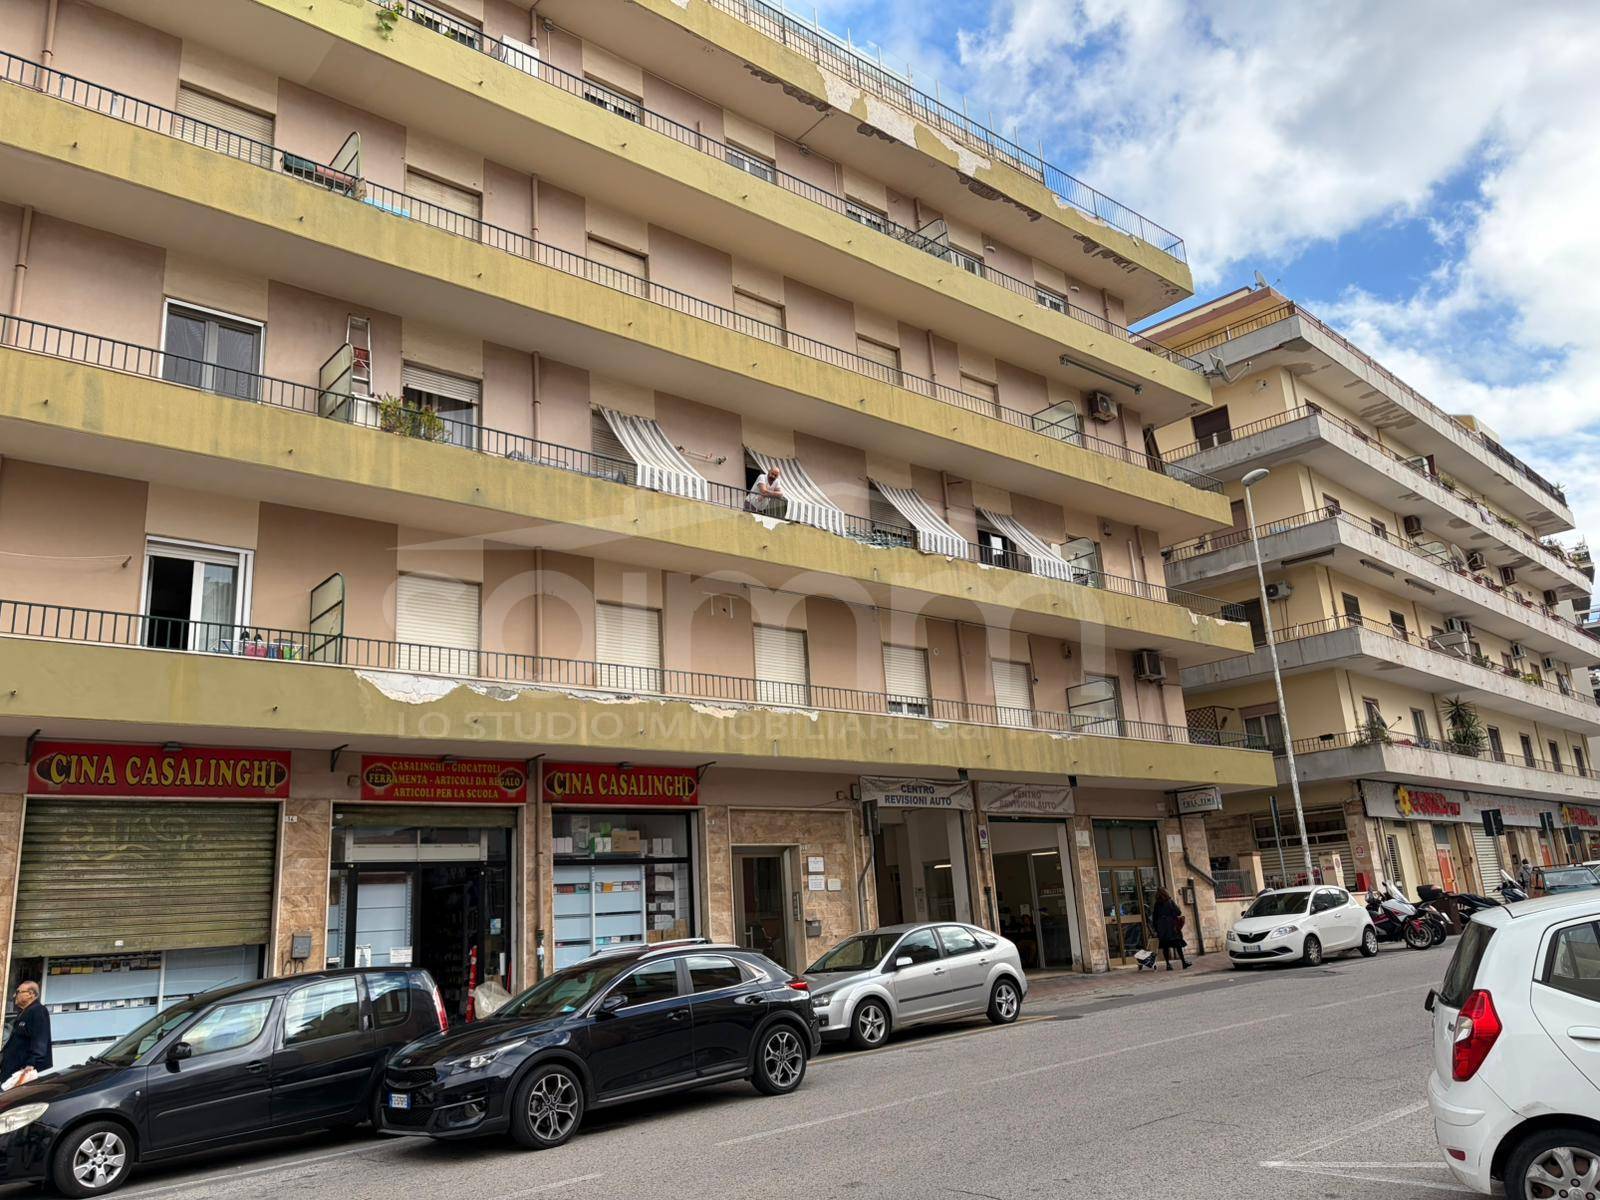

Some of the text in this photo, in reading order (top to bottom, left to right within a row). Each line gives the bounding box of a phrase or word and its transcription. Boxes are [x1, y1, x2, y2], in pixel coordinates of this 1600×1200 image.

[50, 754, 277, 788] CINA CASALINGHI
[391, 761, 445, 772] CASALINGHI
[451, 763, 500, 774] GIOCATTOLI
[369, 773, 428, 785] FERRAMENTA
[434, 775, 475, 786] ARTICOLI
[476, 776, 487, 786] DA
[488, 776, 521, 787] REGALO
[553, 772, 690, 797] CINA CASALINGHI
[393, 788, 499, 799] ARTICOLI PER LA SCUOLA
[900, 784, 935, 795] CENTRO
[1012, 790, 1043, 800] CENTRO
[884, 795, 952, 806] REVISIONI AUTO
[1037, 800, 1057, 810] AUTO
